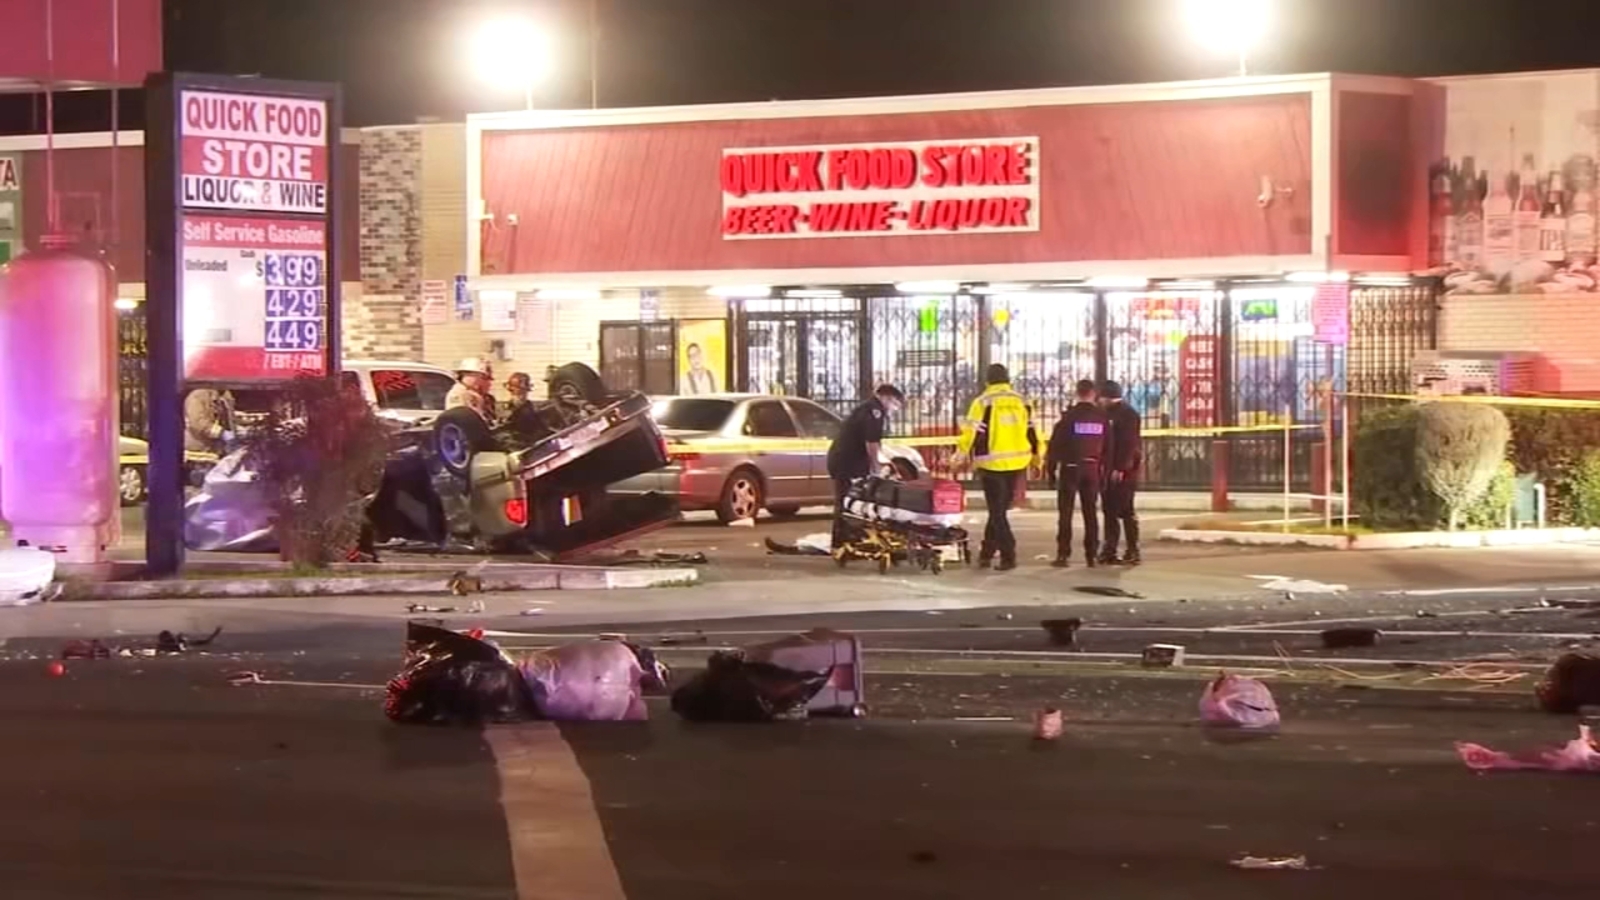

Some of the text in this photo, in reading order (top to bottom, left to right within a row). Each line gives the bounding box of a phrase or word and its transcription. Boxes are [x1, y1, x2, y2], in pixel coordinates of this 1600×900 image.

[186, 96, 322, 137] QUICK FOOD
[202, 139, 312, 181] STORE
[720, 143, 1031, 198] QUICK FOOD STORE
[280, 182, 325, 208] WINE
[183, 220, 323, 245] Self Service Gasoline
[267, 288, 317, 317] 429
[267, 320, 318, 349] 449
